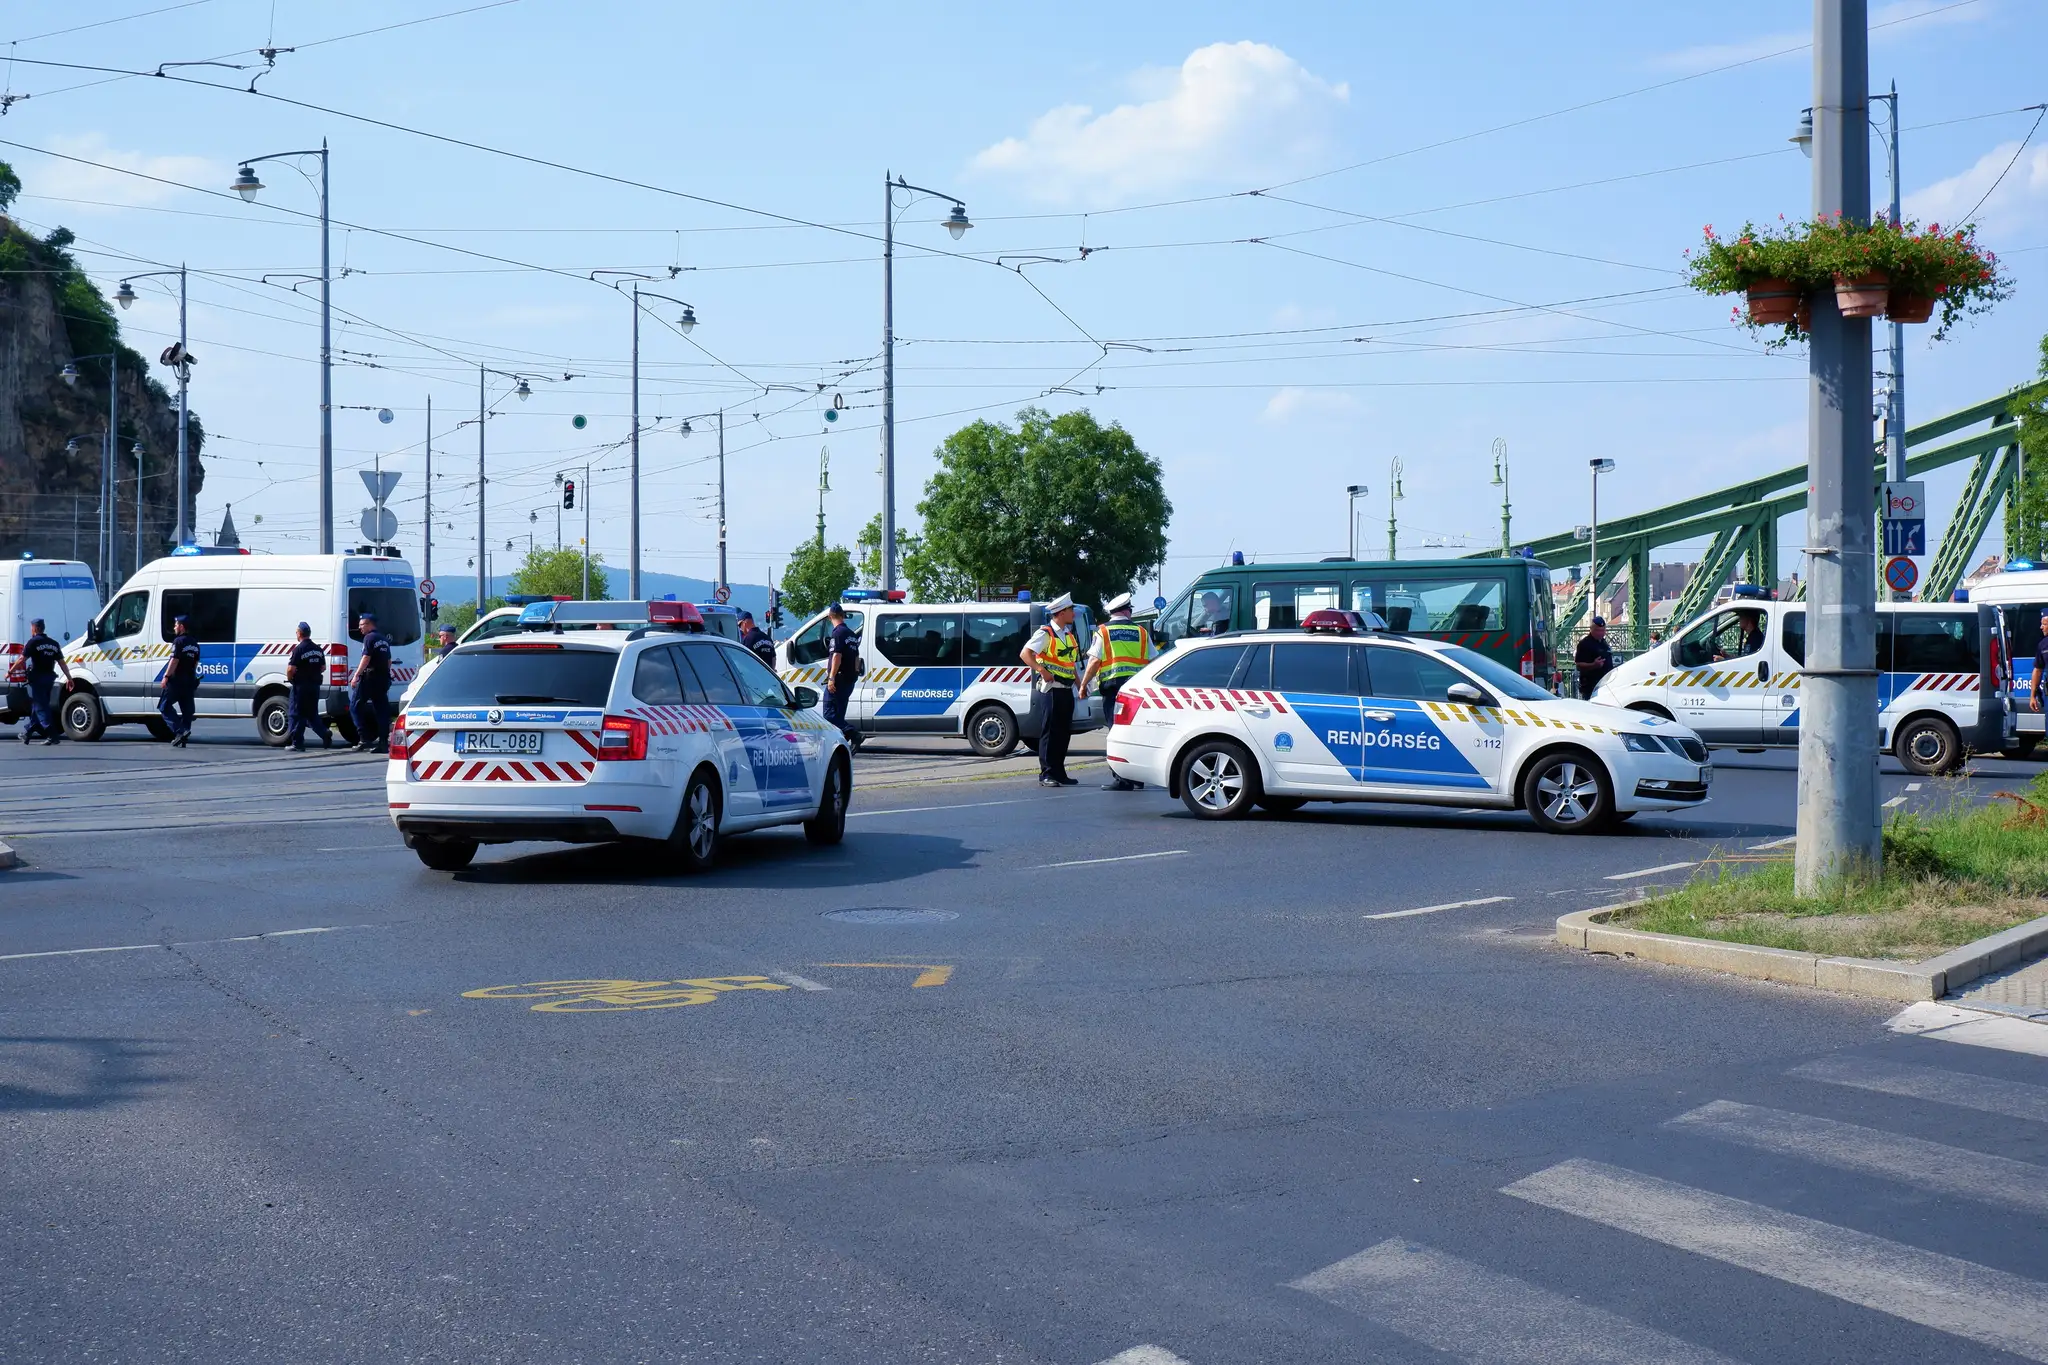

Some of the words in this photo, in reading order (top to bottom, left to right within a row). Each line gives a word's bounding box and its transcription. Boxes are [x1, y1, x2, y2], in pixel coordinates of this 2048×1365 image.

[901, 688, 954, 698] RENDŐRSÉG
[1690, 698, 1706, 706] 112
[441, 712, 477, 720] RENDŐRSÉG
[467, 732, 538, 749] RKL-088
[1327, 729, 1441, 750] RENDŐRSÉG
[1484, 739, 1502, 749] 112
[753, 746, 798, 767] RENDŐRSÉG
